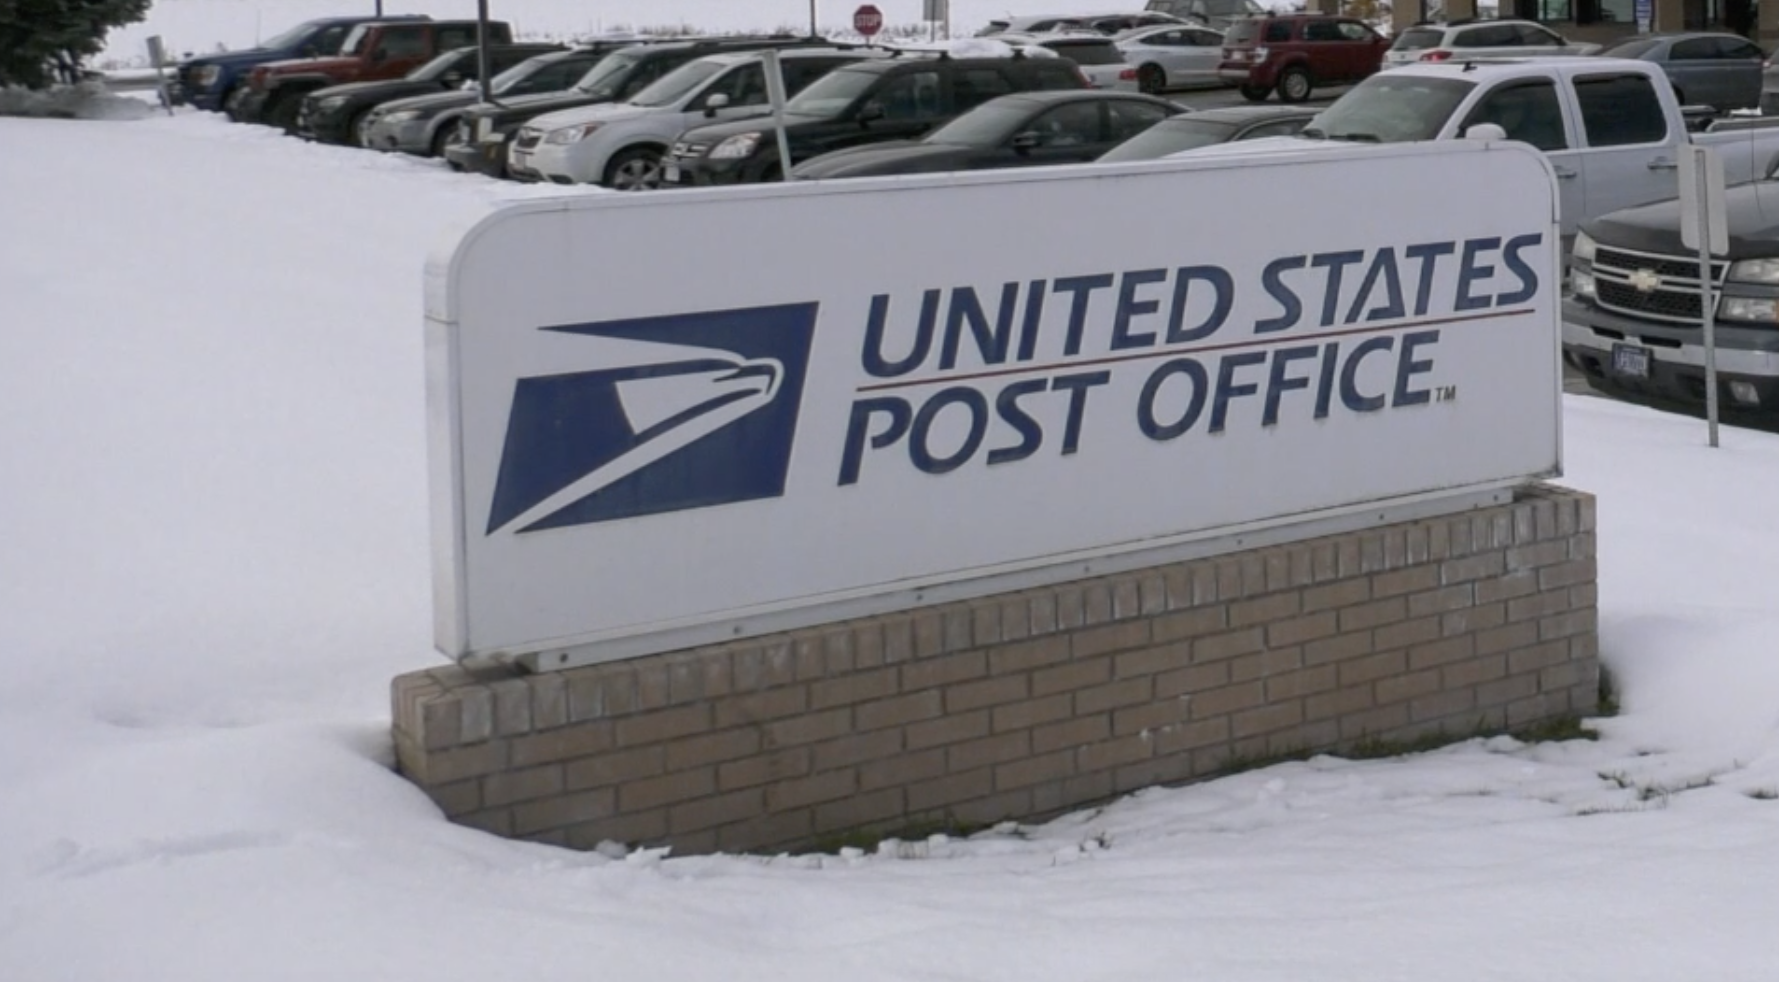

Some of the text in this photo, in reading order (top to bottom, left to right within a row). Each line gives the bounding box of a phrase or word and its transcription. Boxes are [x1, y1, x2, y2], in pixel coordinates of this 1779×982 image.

[856, 14, 882, 27] STOP
[861, 232, 1543, 378] UNITED STATES
[837, 370, 1112, 487] POST
[1137, 329, 1441, 442] OFFICE
